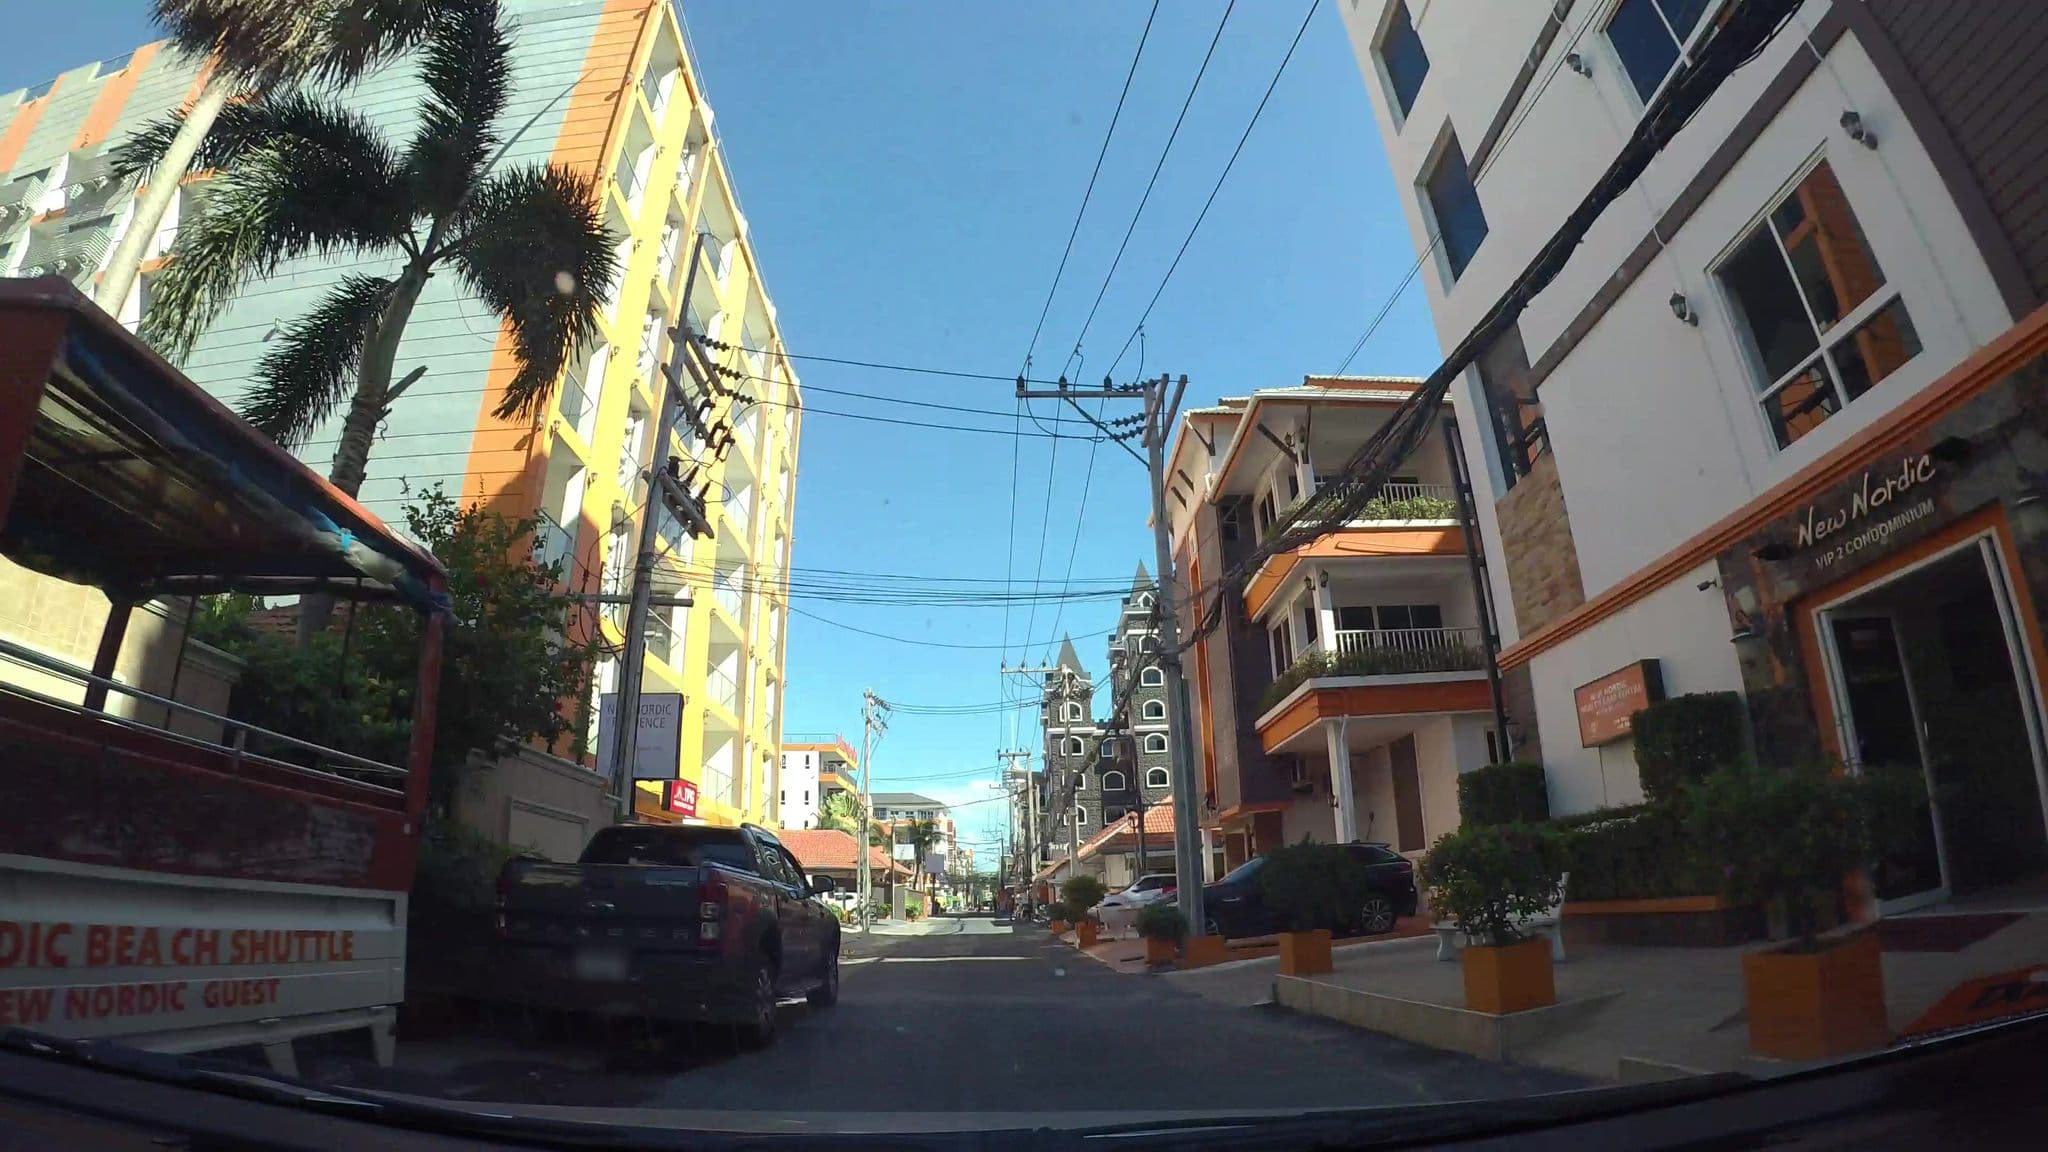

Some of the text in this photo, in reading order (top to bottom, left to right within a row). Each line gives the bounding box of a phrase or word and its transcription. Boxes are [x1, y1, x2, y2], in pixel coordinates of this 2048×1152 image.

[1798, 454, 1936, 547] New Nordic
[1815, 498, 1935, 571] VIP 2 CONDOMINIUM
[640, 703, 672, 716] ORDIC
[86, 924, 220, 968] BEACH
[230, 929, 354, 964] SHUTTLE
[65, 981, 188, 1021] NORDIC
[204, 978, 281, 1009] GUEST
